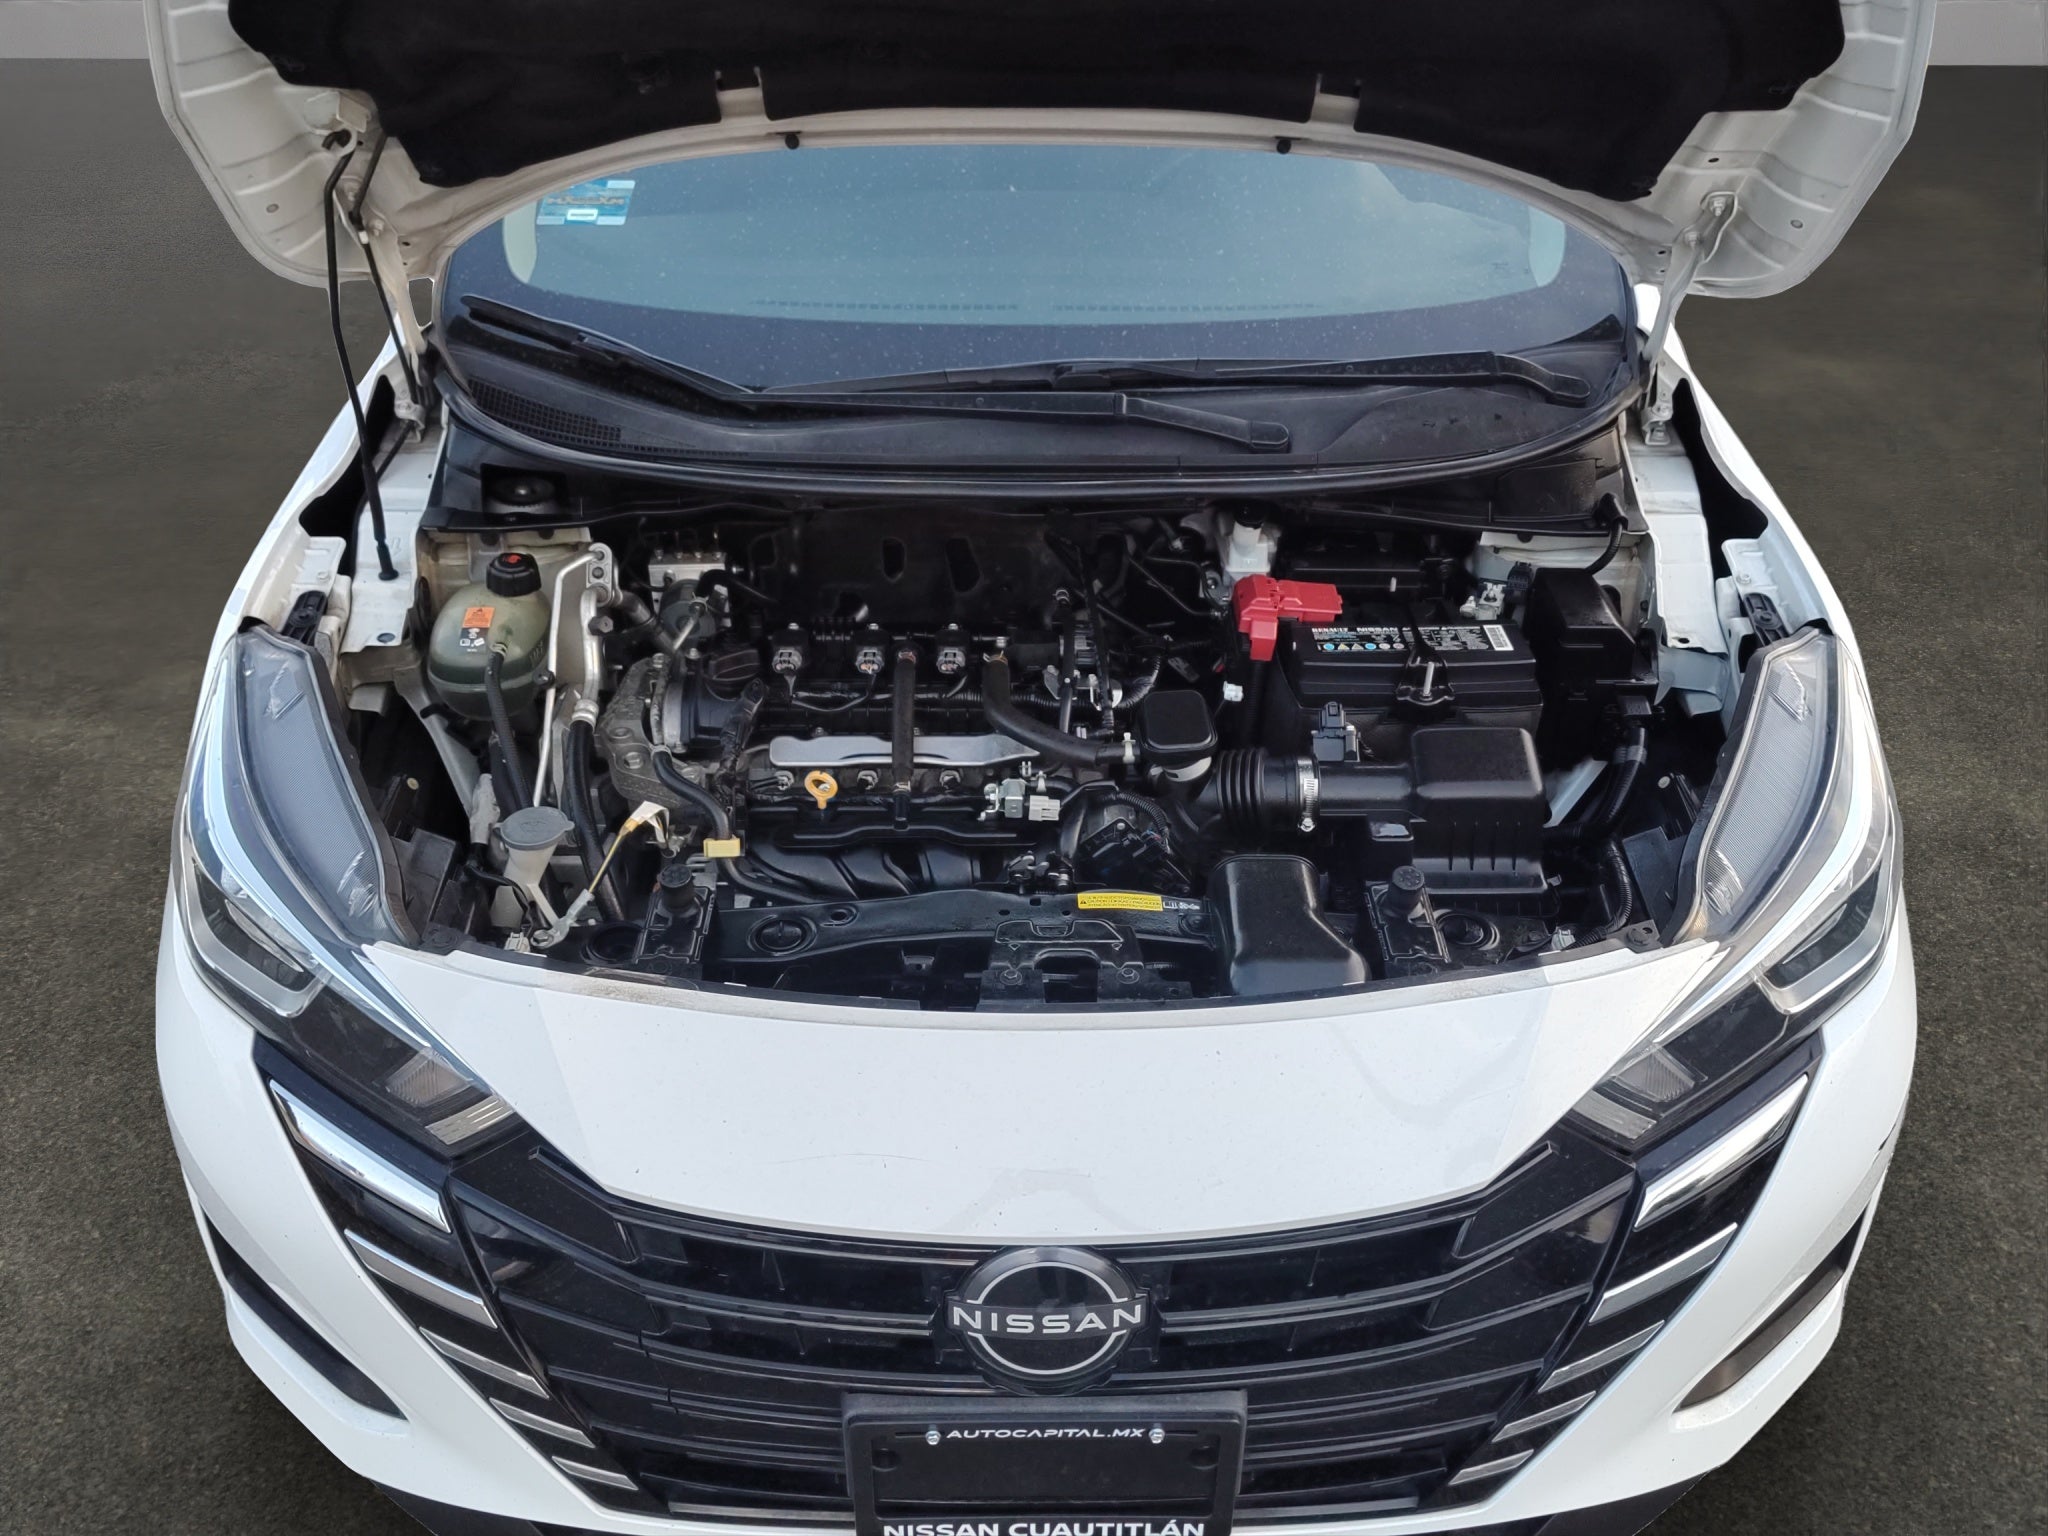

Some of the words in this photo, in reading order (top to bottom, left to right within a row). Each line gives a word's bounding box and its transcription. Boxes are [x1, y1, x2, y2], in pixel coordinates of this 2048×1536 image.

[953, 1303, 1142, 1334] NISSAN
[946, 1428, 1146, 1439] AUTOCAPITAL.MX
[883, 1523, 999, 1536] NISSAN
[1008, 1519, 1205, 1536] CUAUTITLÁN
